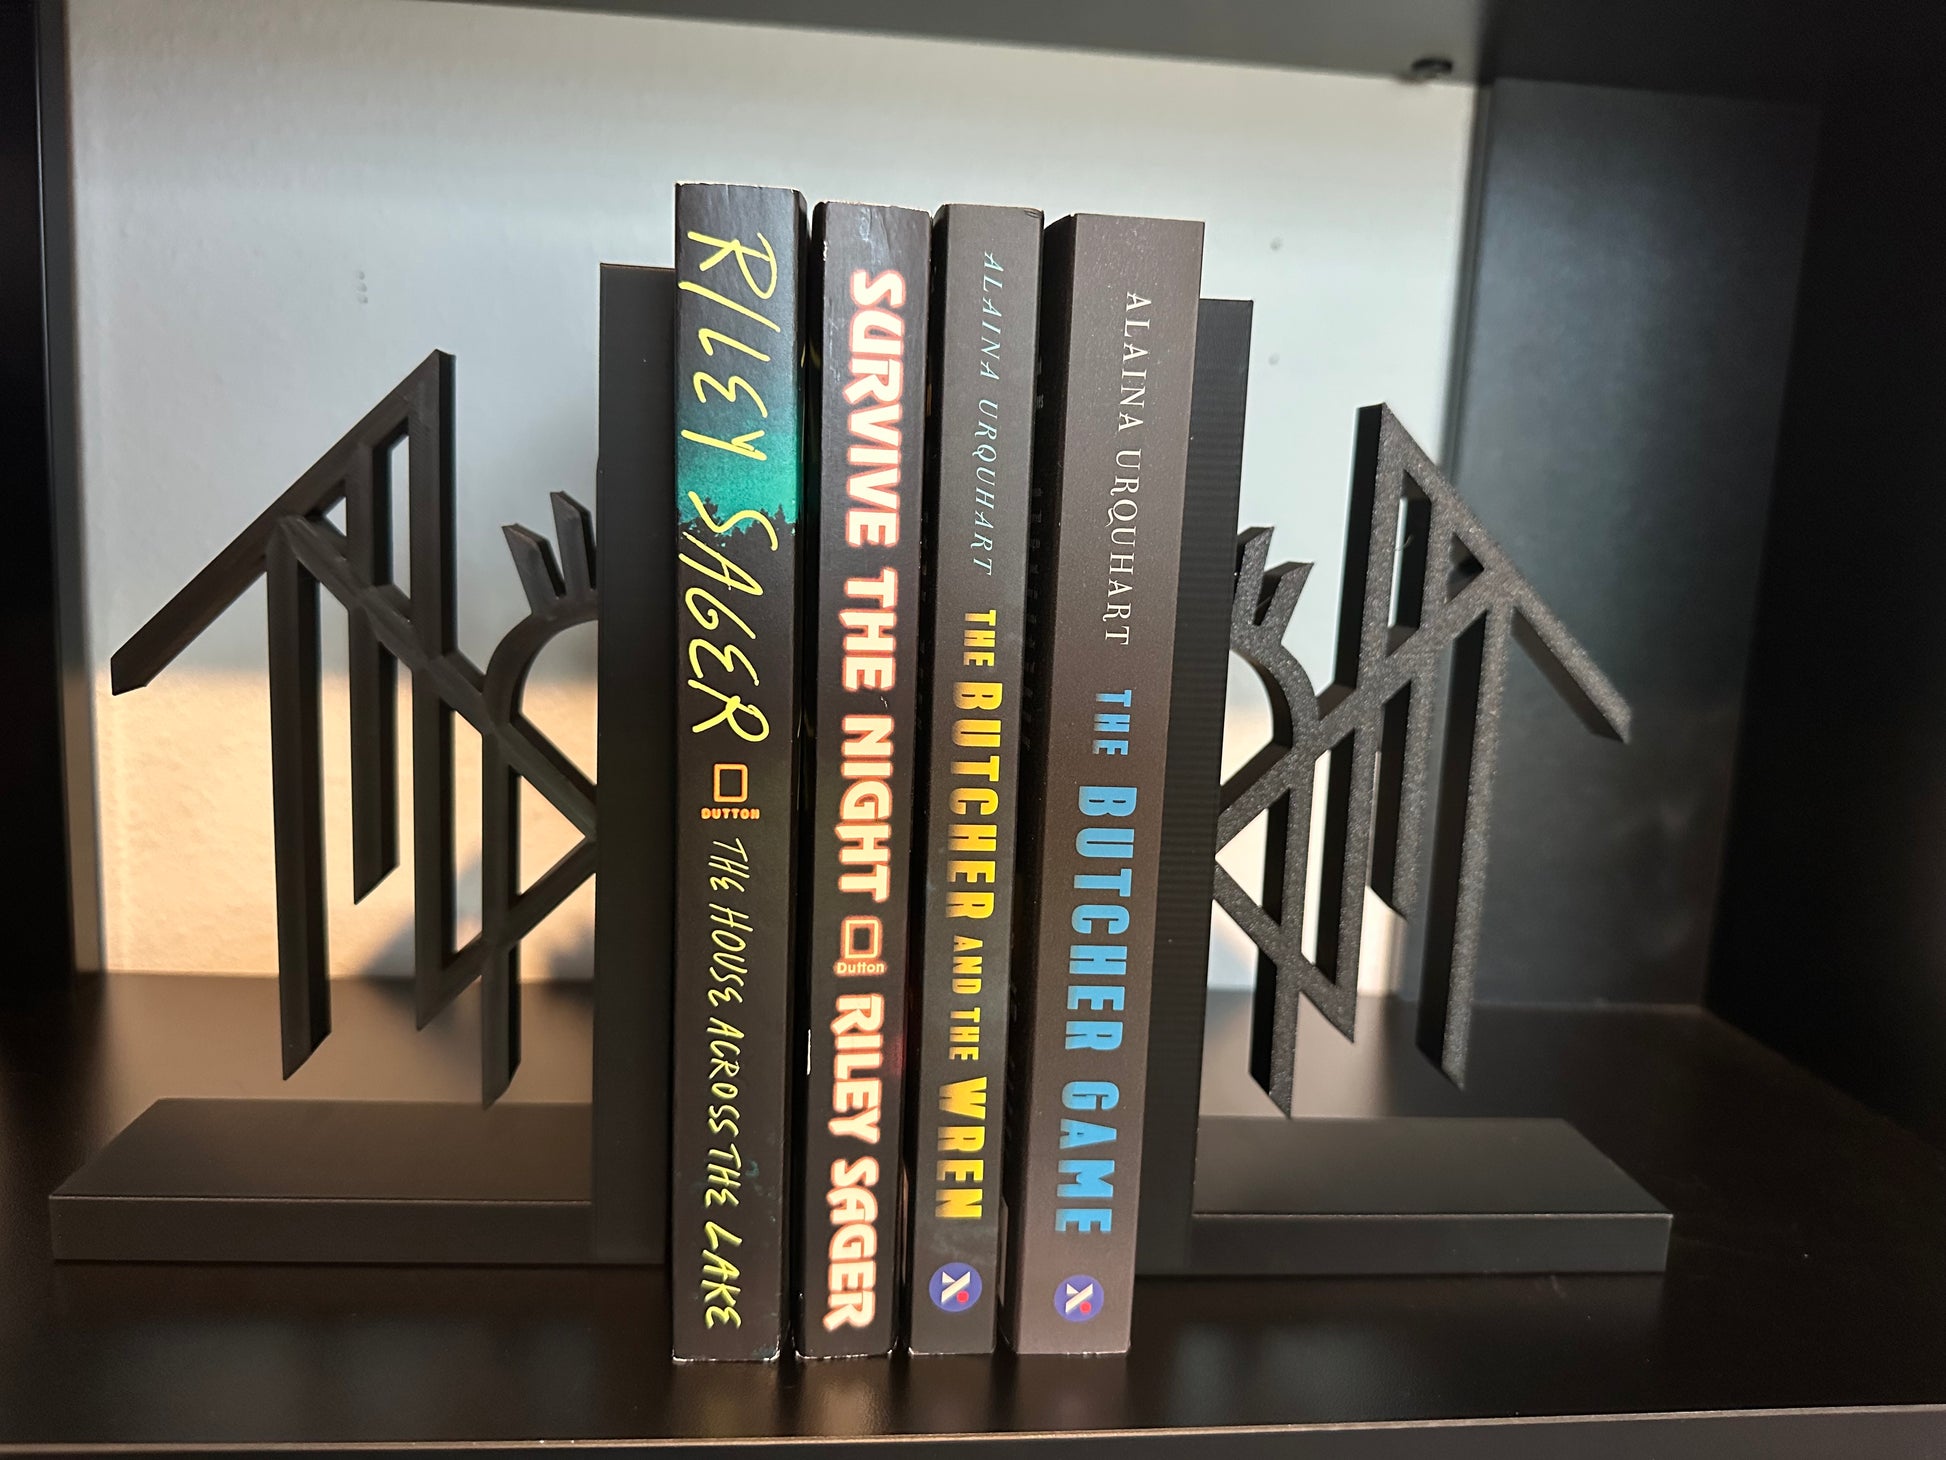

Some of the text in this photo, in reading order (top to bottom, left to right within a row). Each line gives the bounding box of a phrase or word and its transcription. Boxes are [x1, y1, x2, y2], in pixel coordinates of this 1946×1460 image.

[678, 230, 781, 743] RILEY SAGER
[839, 268, 907, 903] SURVIVE THE NIGHT
[971, 252, 1004, 575] ALAINA URQUHART
[1103, 292, 1153, 646] ALAINA URQUHART
[701, 808, 760, 820] DUTTON
[836, 960, 885, 974] Dutton
[935, 610, 1003, 1219] THE BUTCHER AND THE WREN
[1055, 689, 1138, 1233] THE BUTCHER GAME
[703, 838, 753, 1329] THE HOUSE ACROSS THE LAKE
[822, 993, 884, 1332] RILEY SAGER
